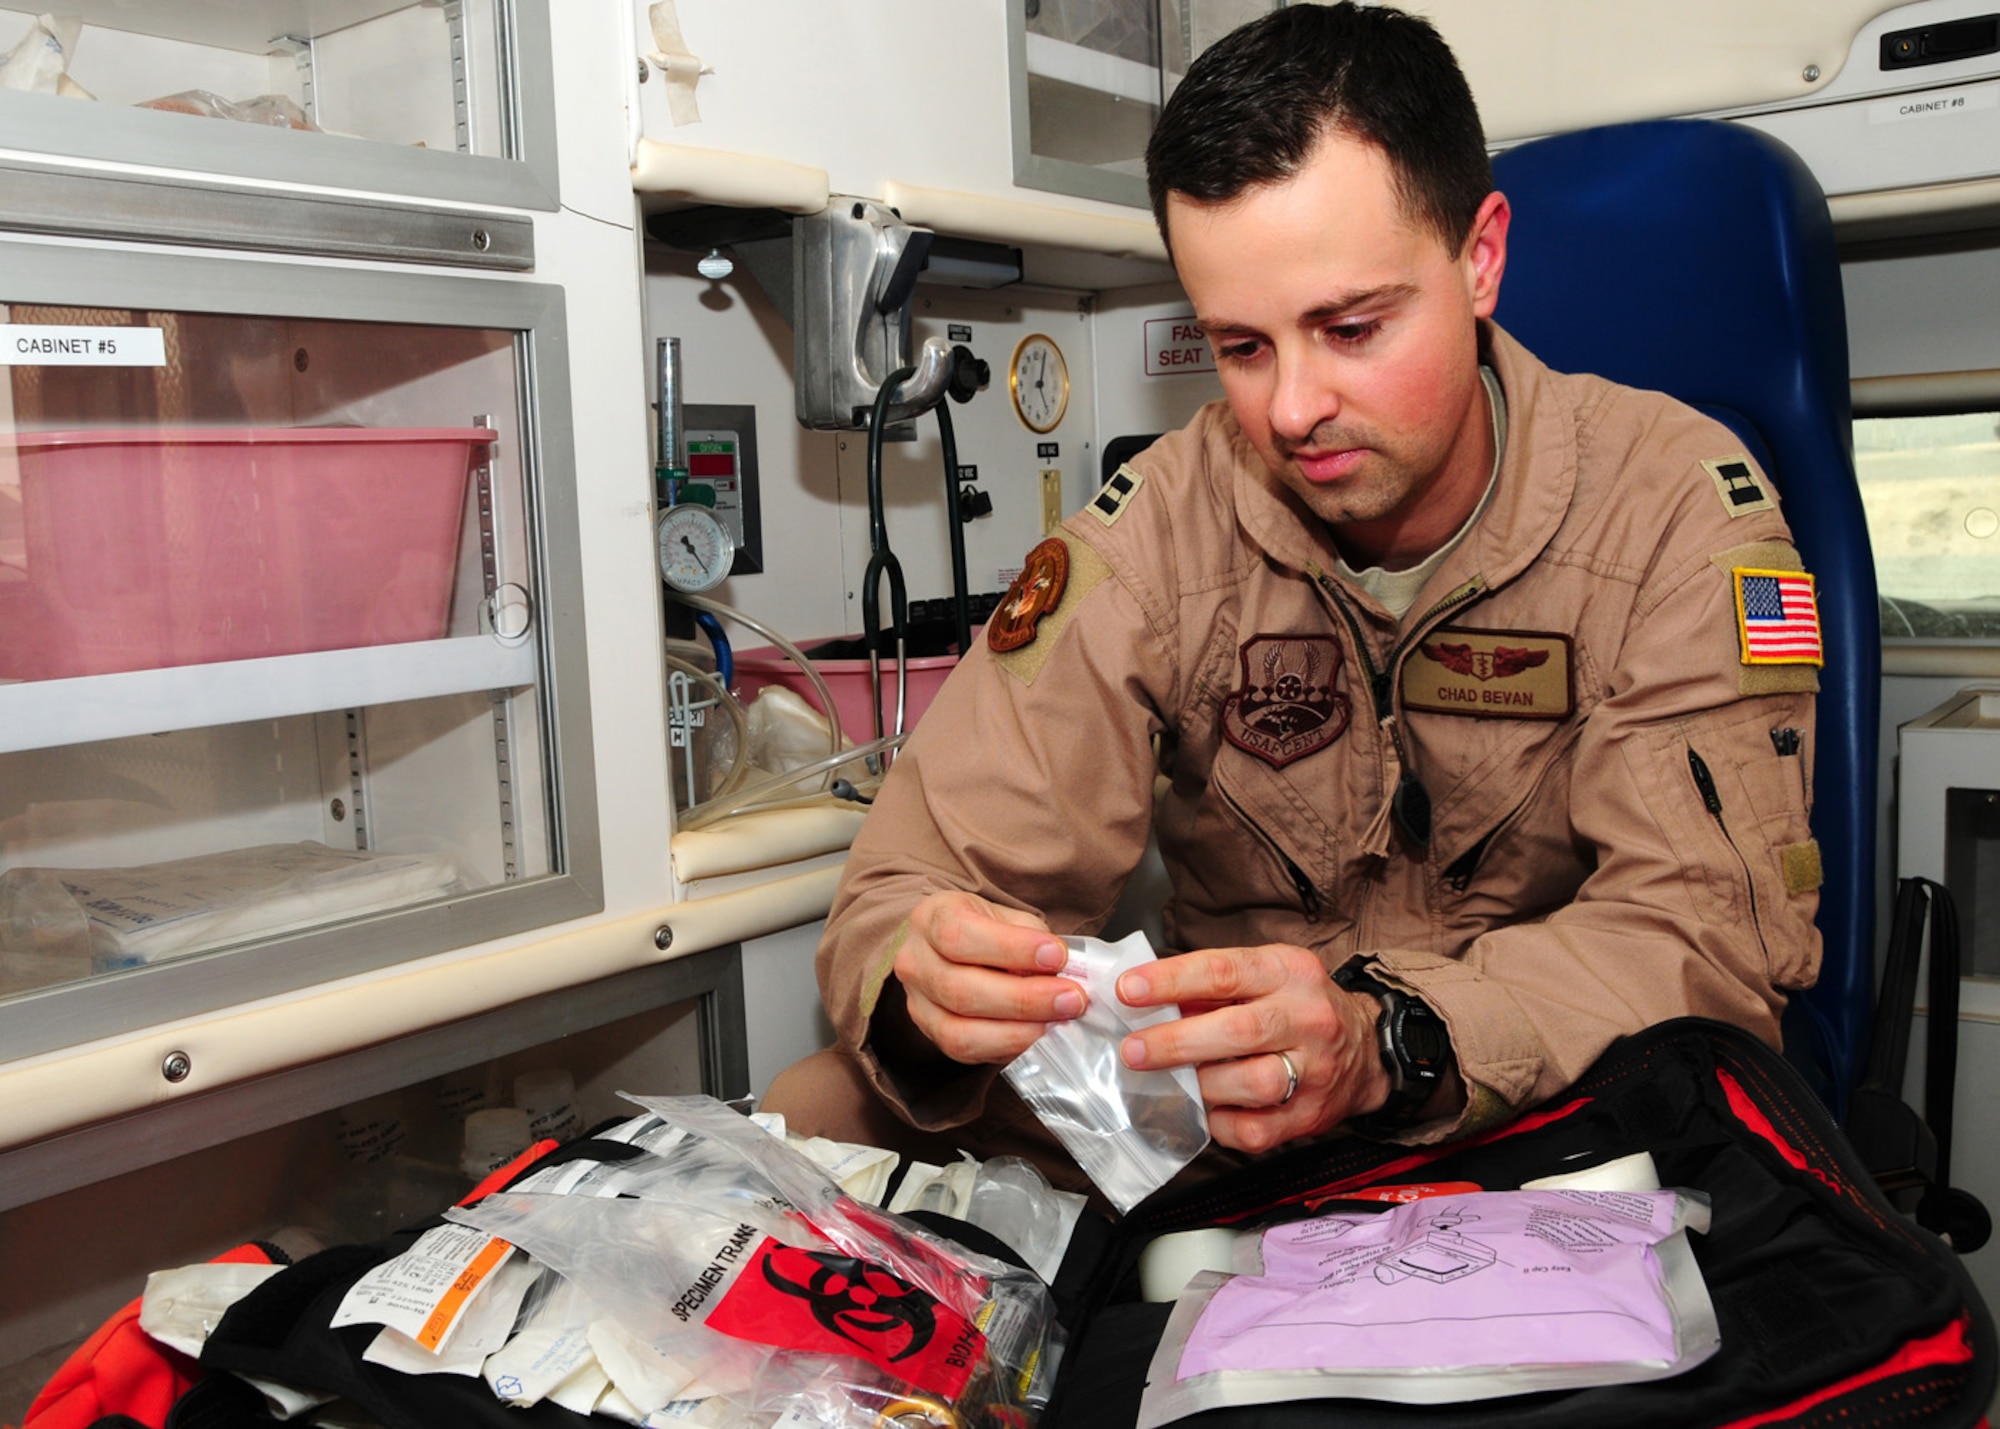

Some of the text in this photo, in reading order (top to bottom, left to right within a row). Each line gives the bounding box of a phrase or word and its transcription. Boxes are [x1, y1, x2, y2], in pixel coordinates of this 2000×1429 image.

[1899, 97, 1965, 115] CABINET #8
[1172, 325, 1206, 341] FAS
[16, 338, 117, 354] CABINET #5
[1158, 347, 1203, 366] SEAT
[1437, 687, 1534, 706] CHAD BEVAN
[1240, 729, 1325, 756] USAFCENT
[671, 1223, 758, 1322] SPECIMEN TRANS
